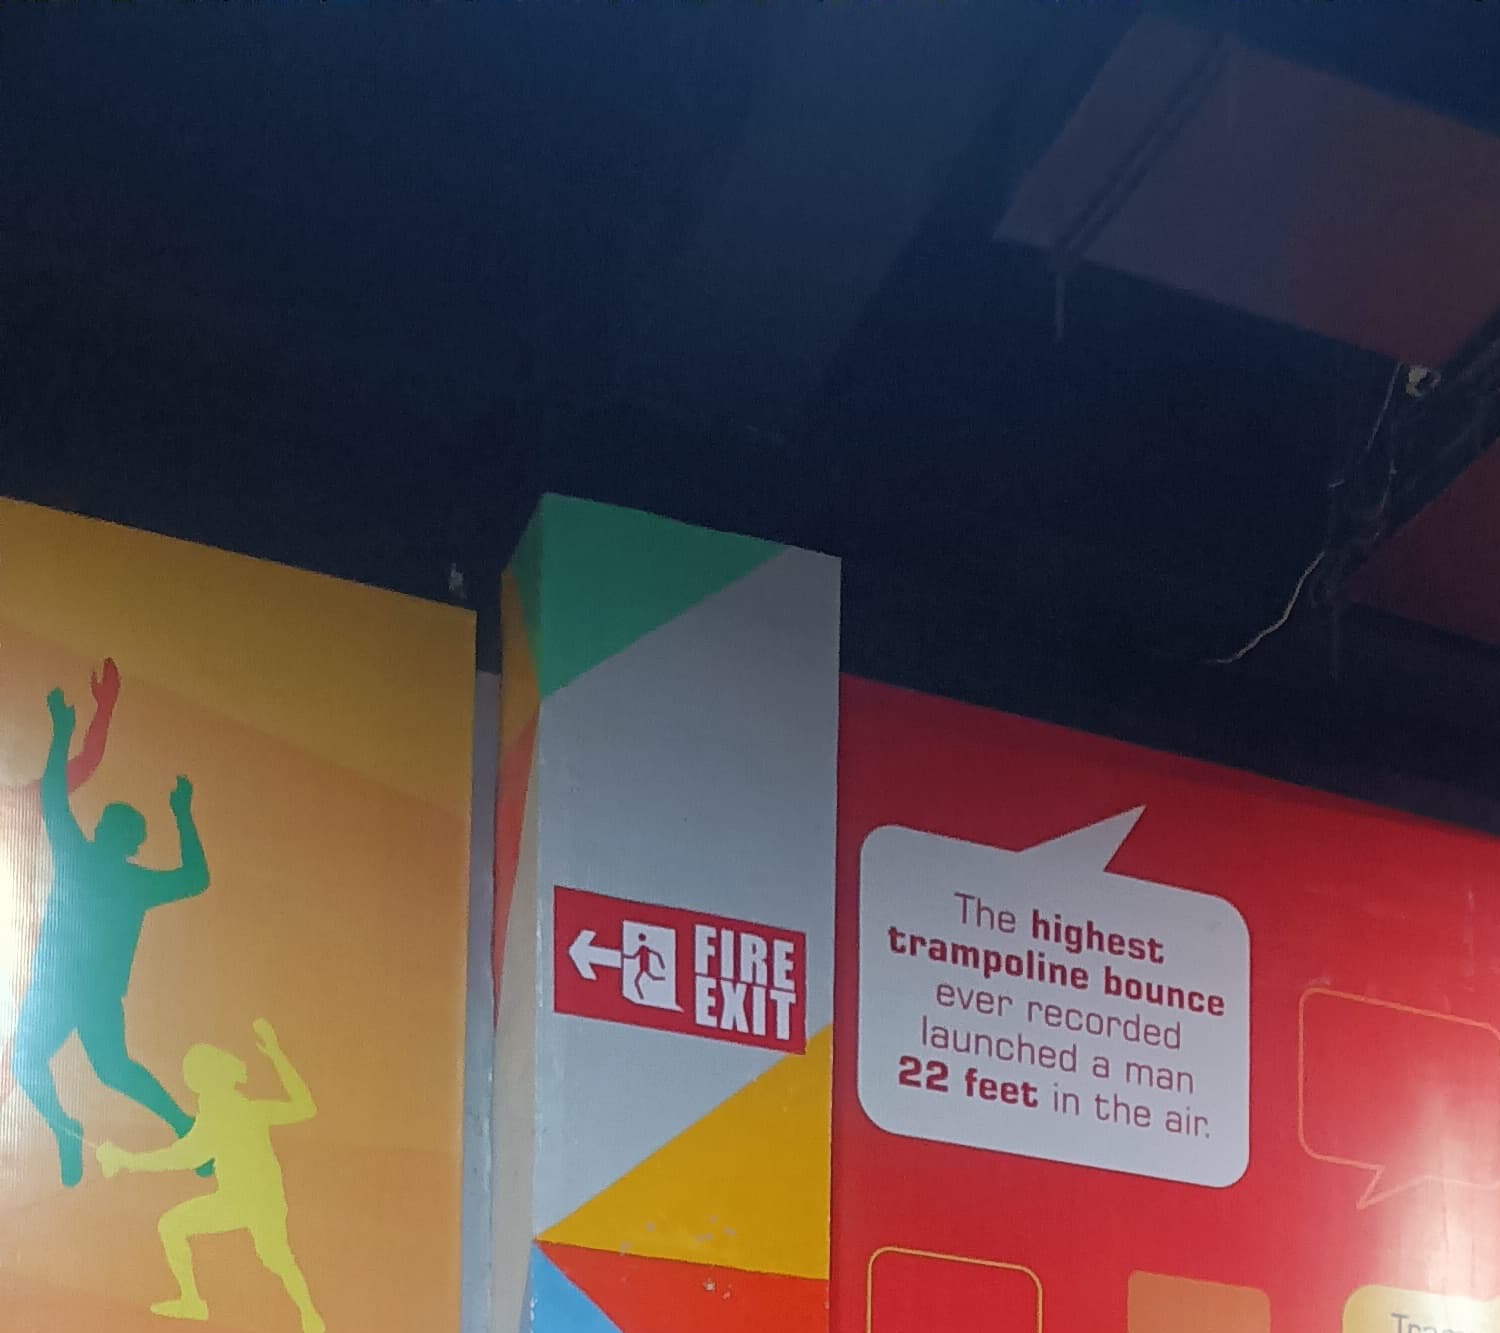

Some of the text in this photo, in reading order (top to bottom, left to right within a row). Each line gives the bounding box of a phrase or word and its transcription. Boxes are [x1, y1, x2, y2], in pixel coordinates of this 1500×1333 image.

[694, 924, 796, 992] FIRE
[954, 892, 1164, 964] The highest
[889, 926, 1226, 1017] trampoline bounce
[694, 977, 796, 1041] EXIT
[936, 982, 1181, 1050] ever recorded
[922, 1016, 1194, 1094] launched a man
[899, 1056, 1211, 1139] 22 feet in the air.
